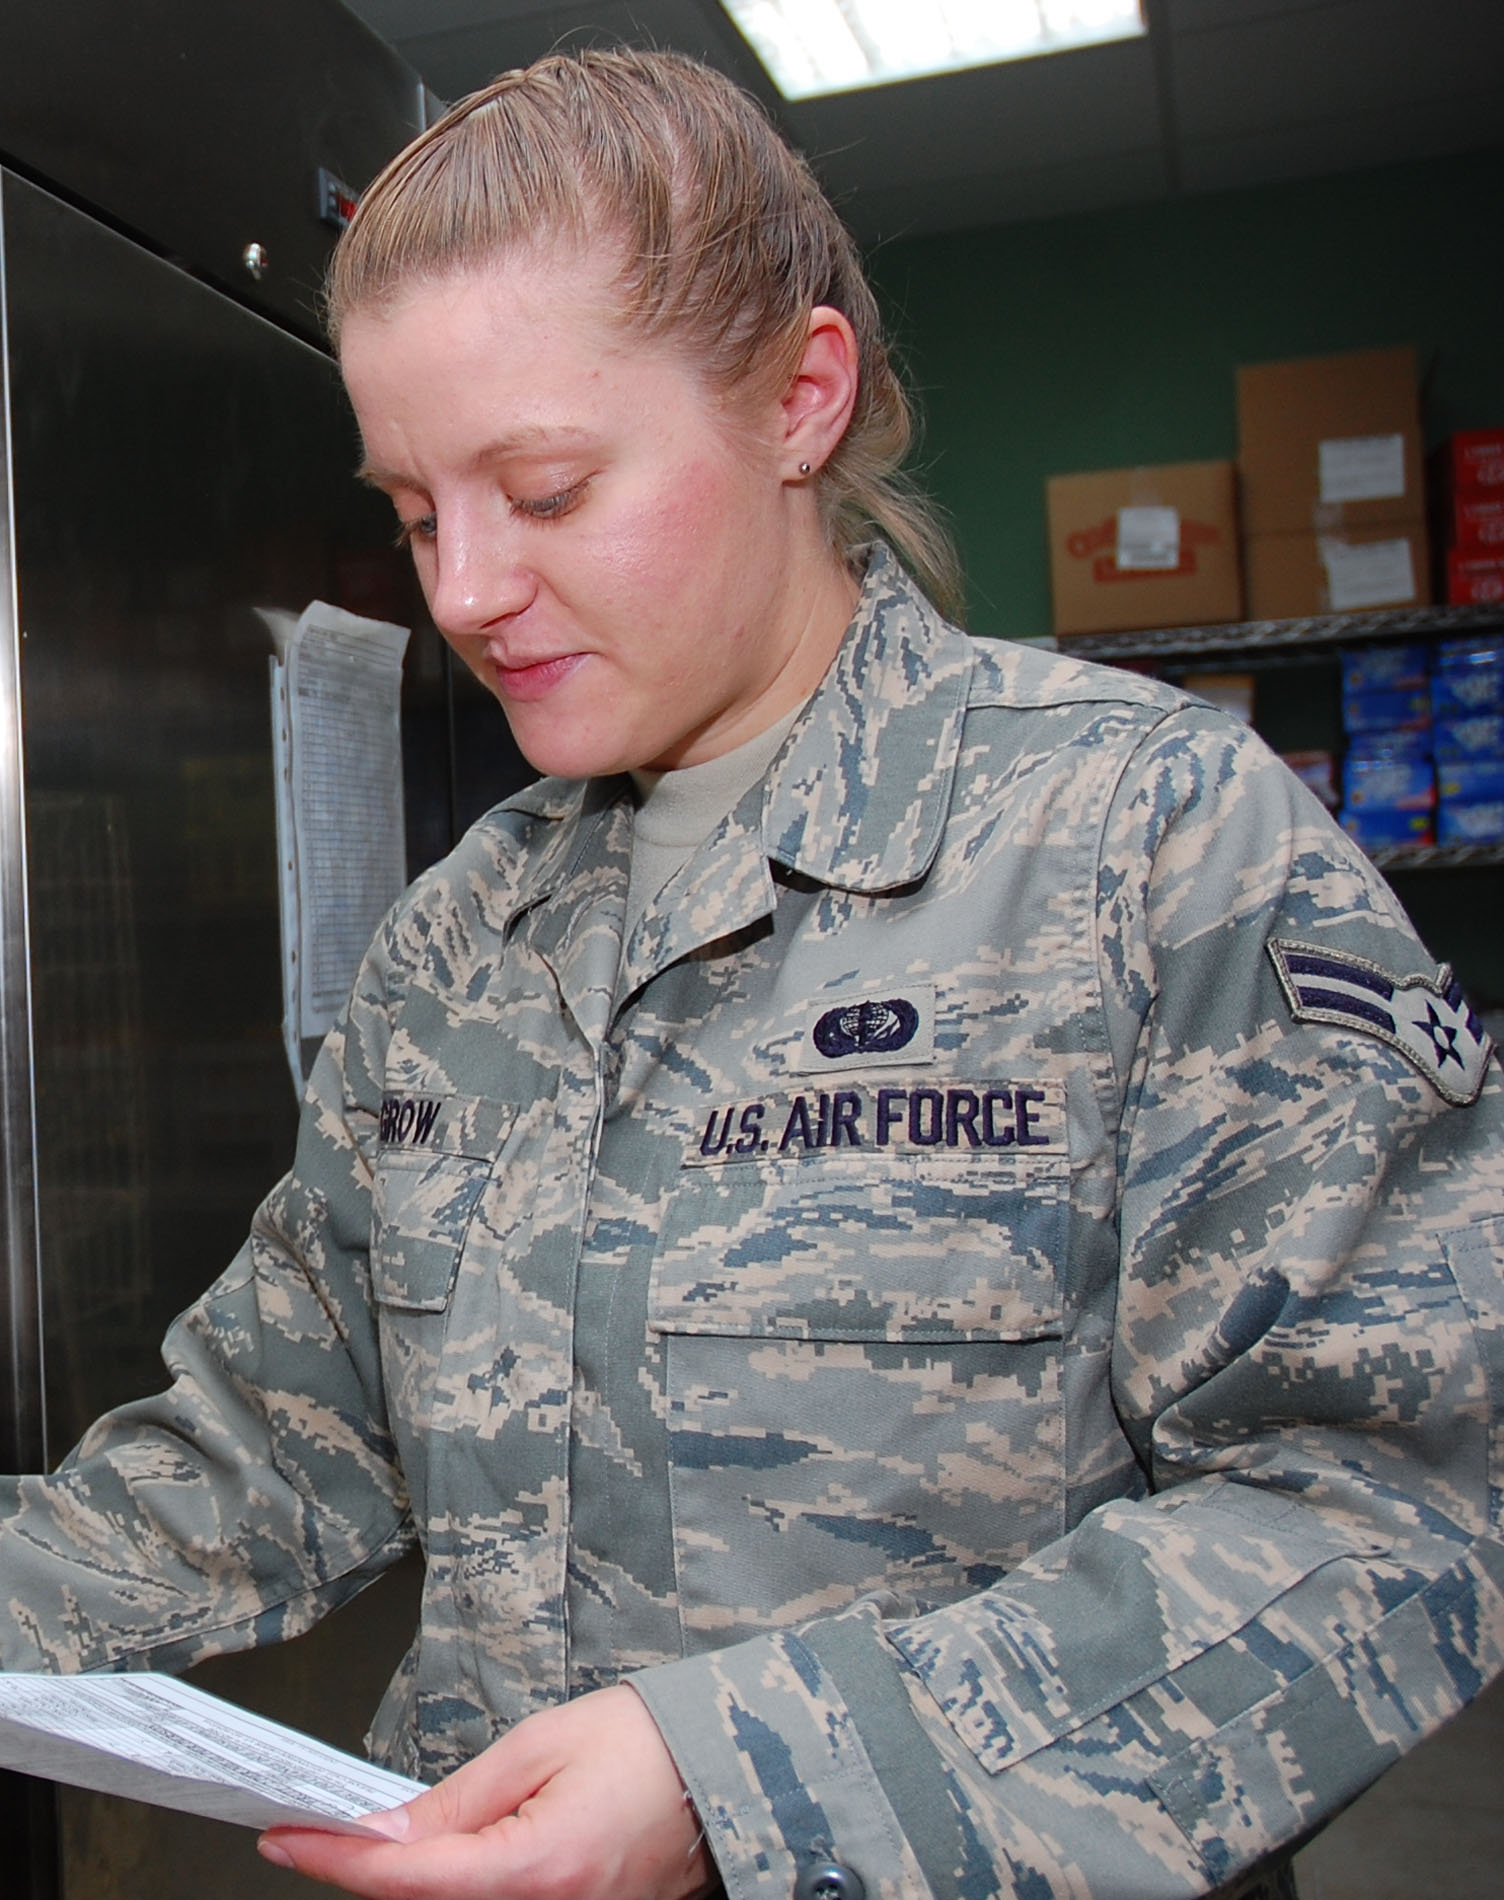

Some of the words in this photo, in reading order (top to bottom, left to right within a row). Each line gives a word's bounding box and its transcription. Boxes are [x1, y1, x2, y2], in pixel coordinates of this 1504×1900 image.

[700, 1104, 770, 1156] U.S.
[780, 1090, 863, 1151] AIR
[877, 1088, 1048, 1147] FORCE
